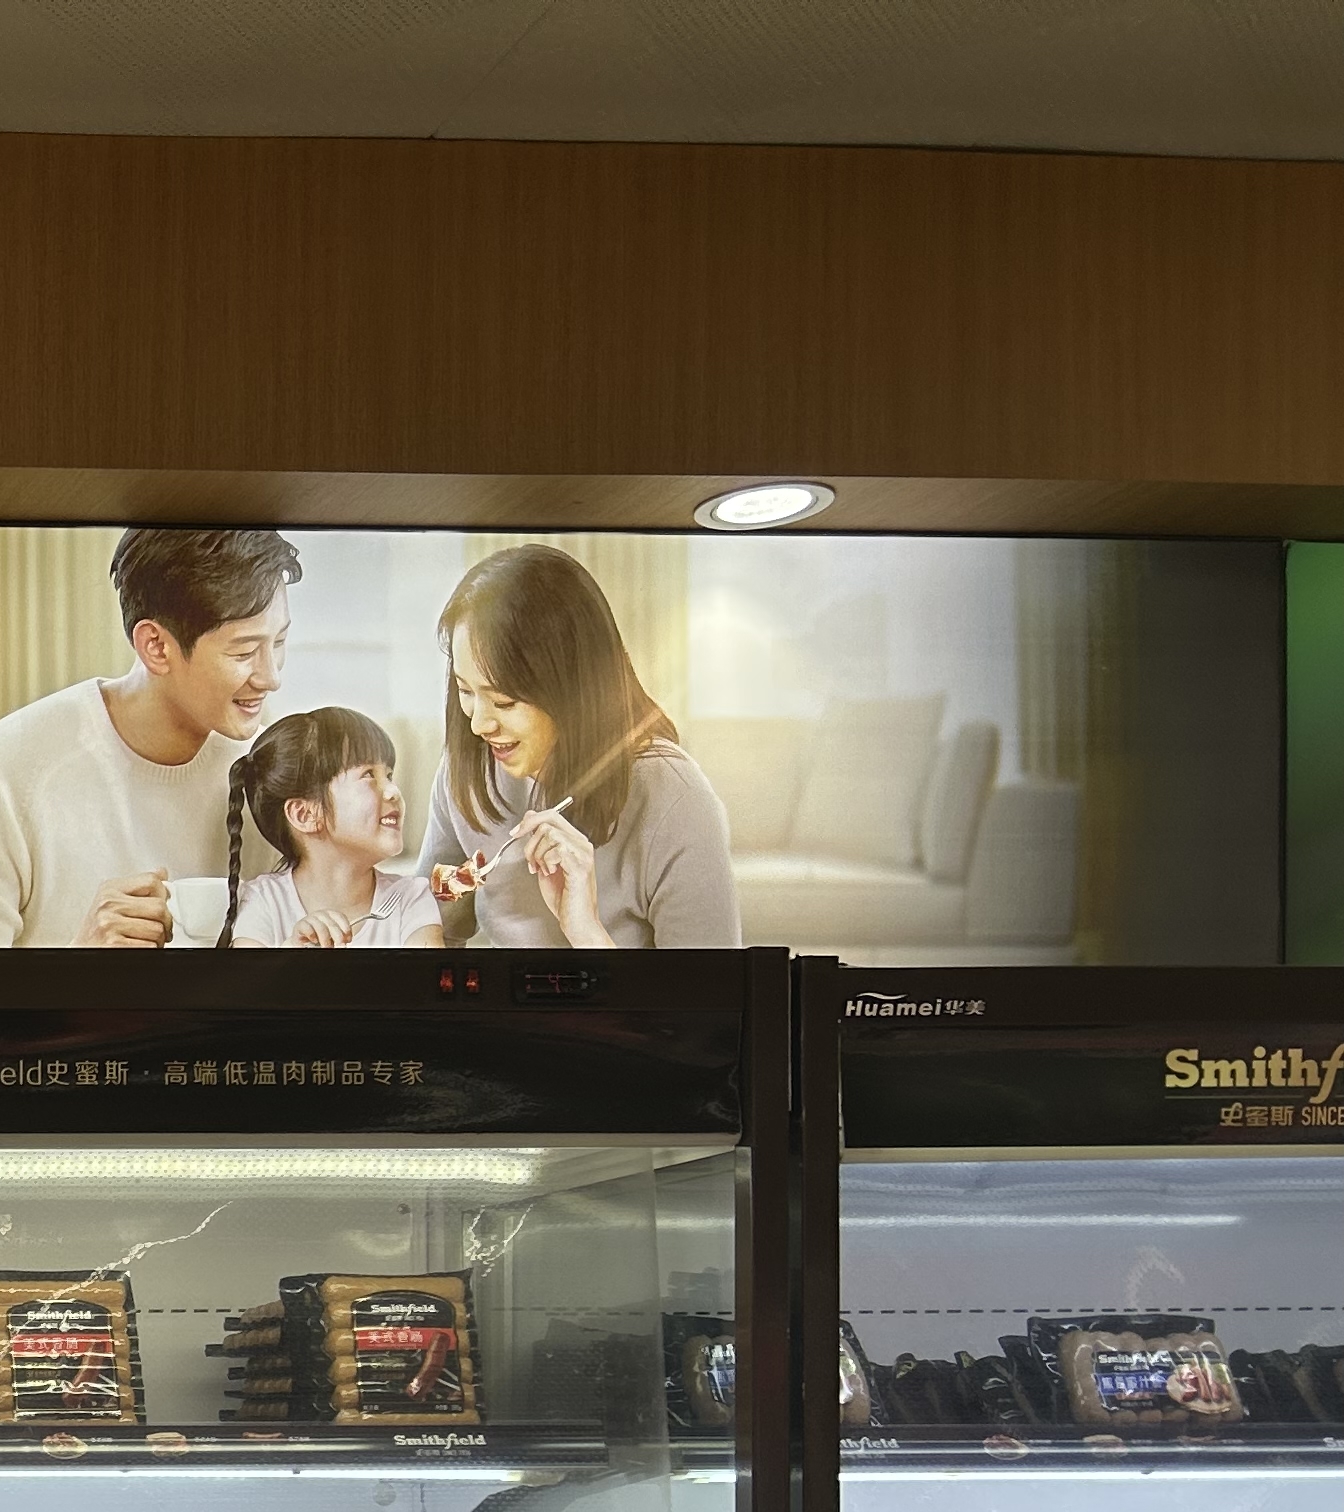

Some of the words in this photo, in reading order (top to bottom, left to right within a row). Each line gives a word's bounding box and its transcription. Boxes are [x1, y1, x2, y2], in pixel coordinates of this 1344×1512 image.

[370, 1303, 436, 1316] Smithfield
[27, 1310, 92, 1324] Smithfield
[394, 1433, 487, 1449] Smithfield
